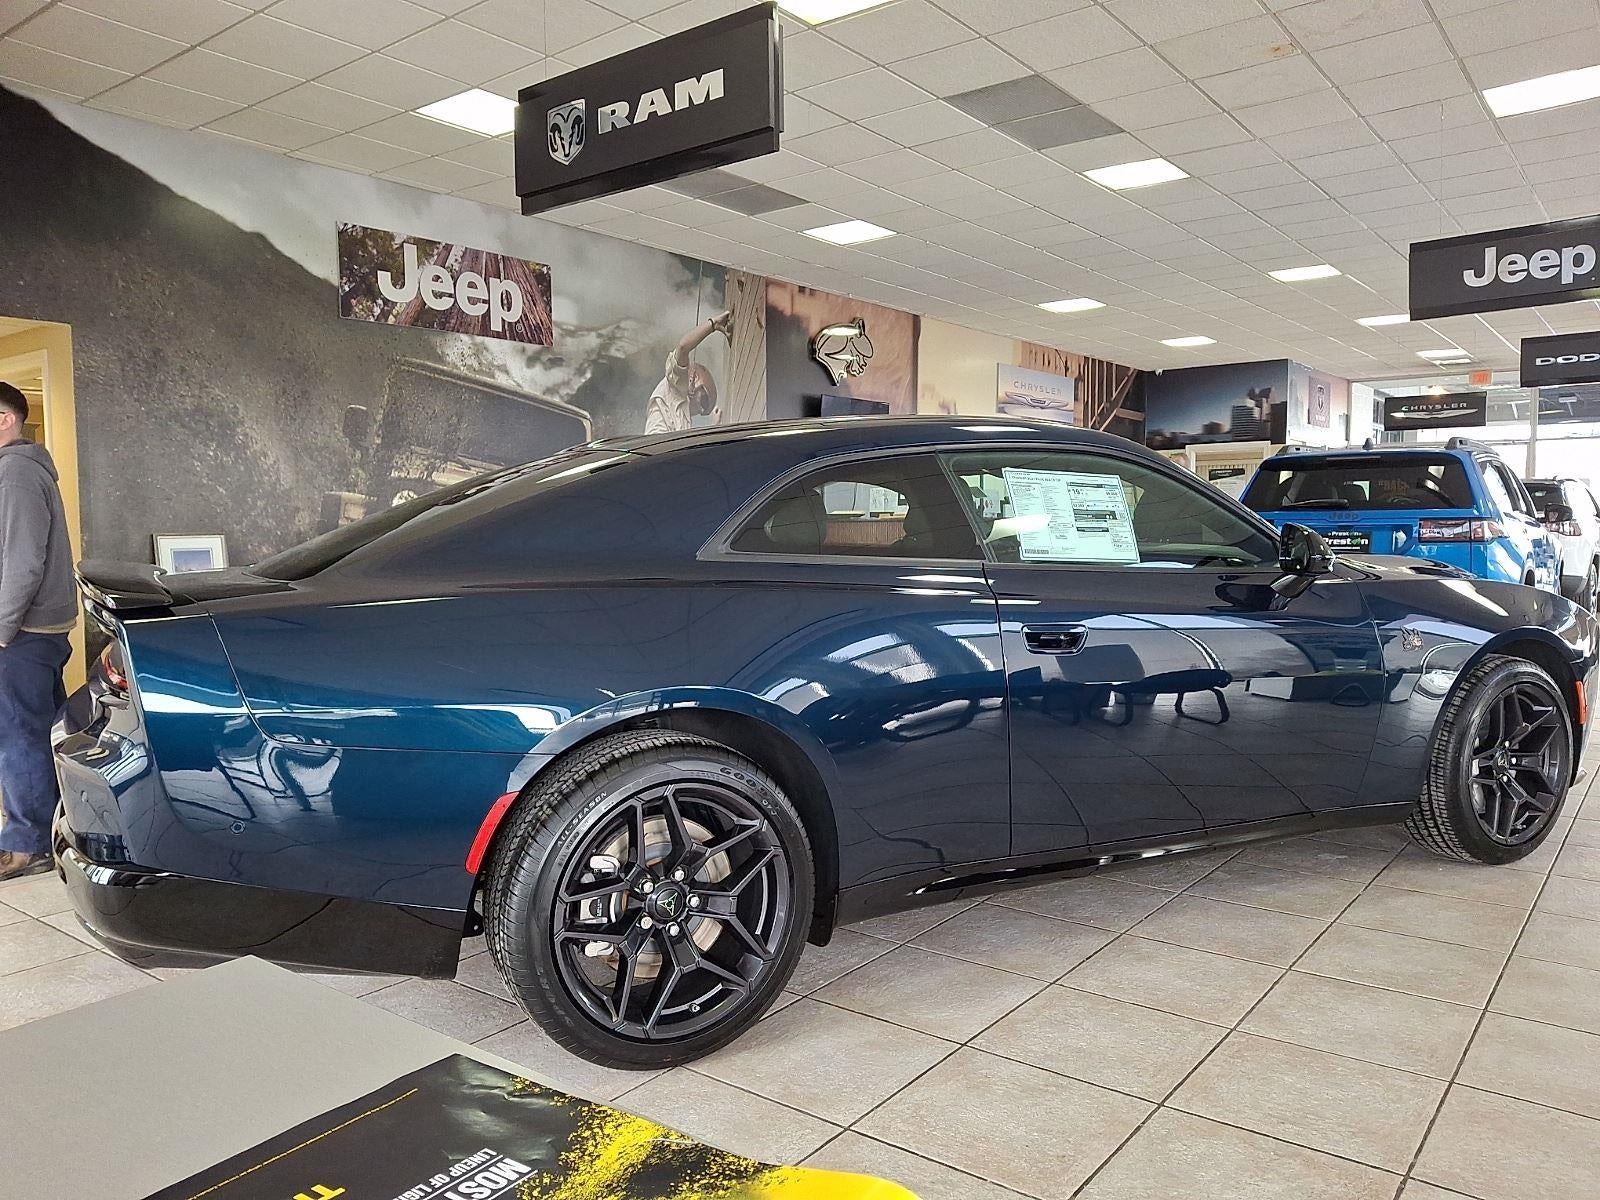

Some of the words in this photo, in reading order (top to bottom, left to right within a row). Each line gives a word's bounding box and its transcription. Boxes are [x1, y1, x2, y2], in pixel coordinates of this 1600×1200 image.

[598, 68, 724, 135] RAM
[1463, 244, 1596, 288] Jeep
[377, 243, 523, 332] Jeep
[1401, 402, 1468, 411] CHRYSLER
[450, 1148, 497, 1177] LINEUP
[428, 1174, 450, 1188] OF
